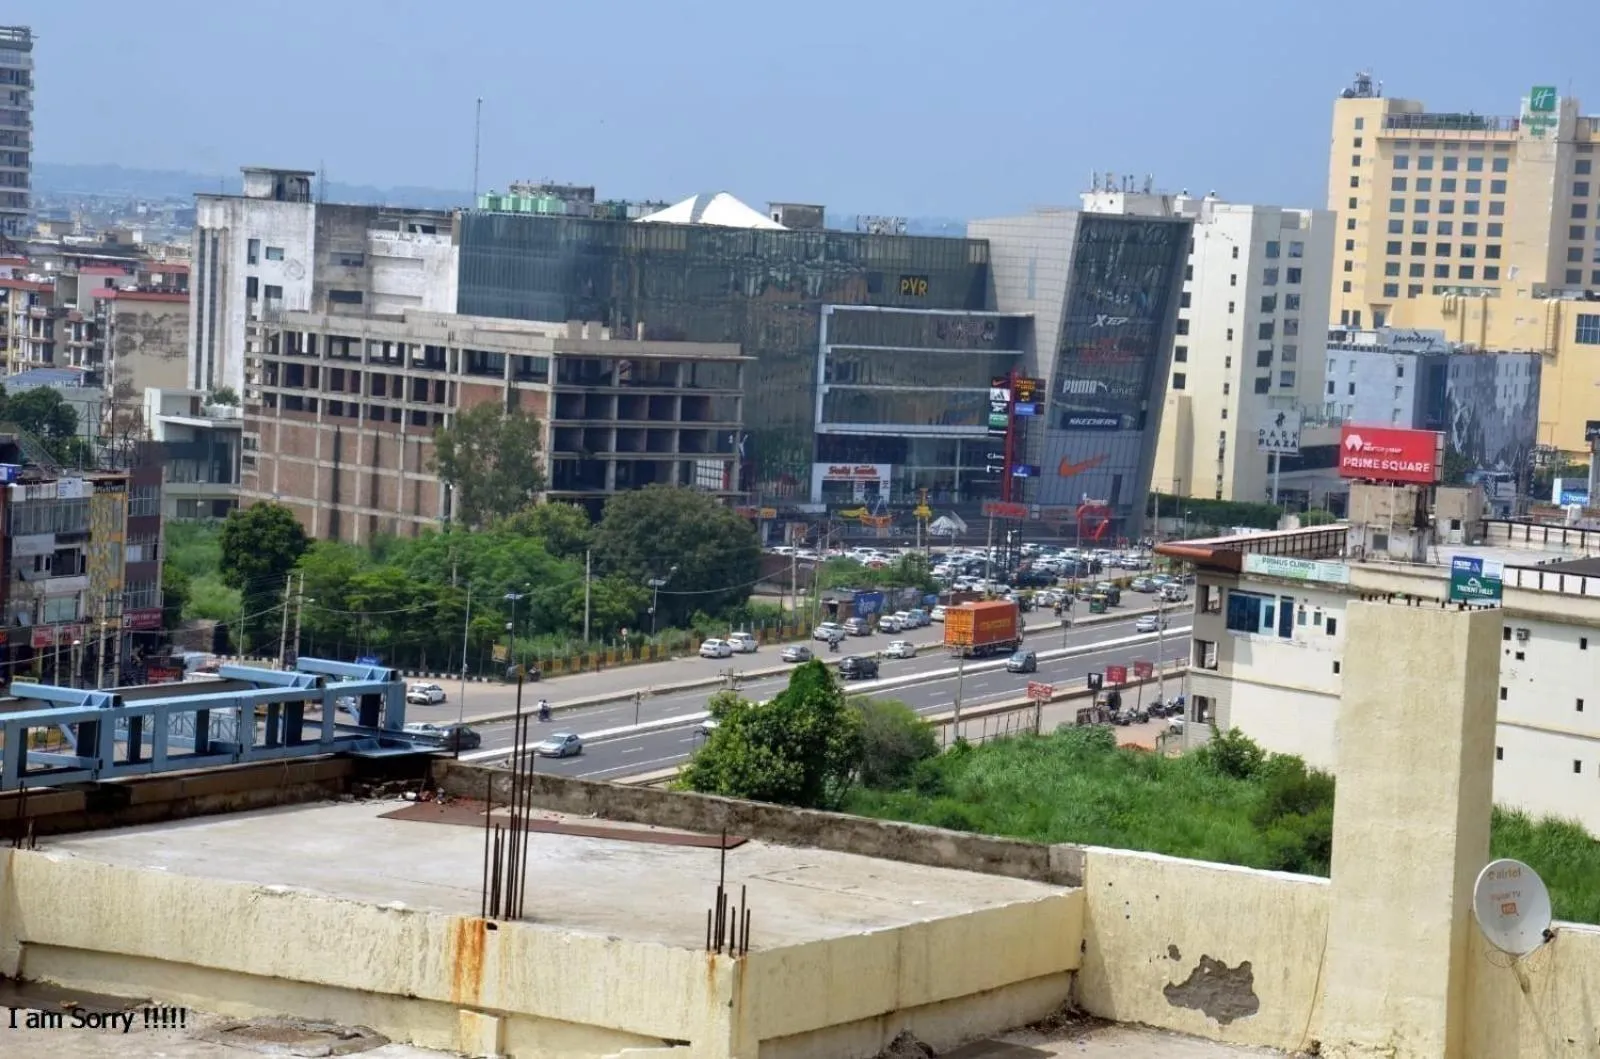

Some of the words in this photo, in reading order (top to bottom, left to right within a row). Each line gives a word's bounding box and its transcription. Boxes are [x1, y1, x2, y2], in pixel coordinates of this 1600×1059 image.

[900, 276, 929, 297] PVR
[1062, 380, 1098, 394] PUMA
[1259, 429, 1298, 440] PARK
[1258, 438, 1297, 448] PLAZA
[1343, 457, 1380, 469] PRIME
[1381, 459, 1431, 473] SQUARE
